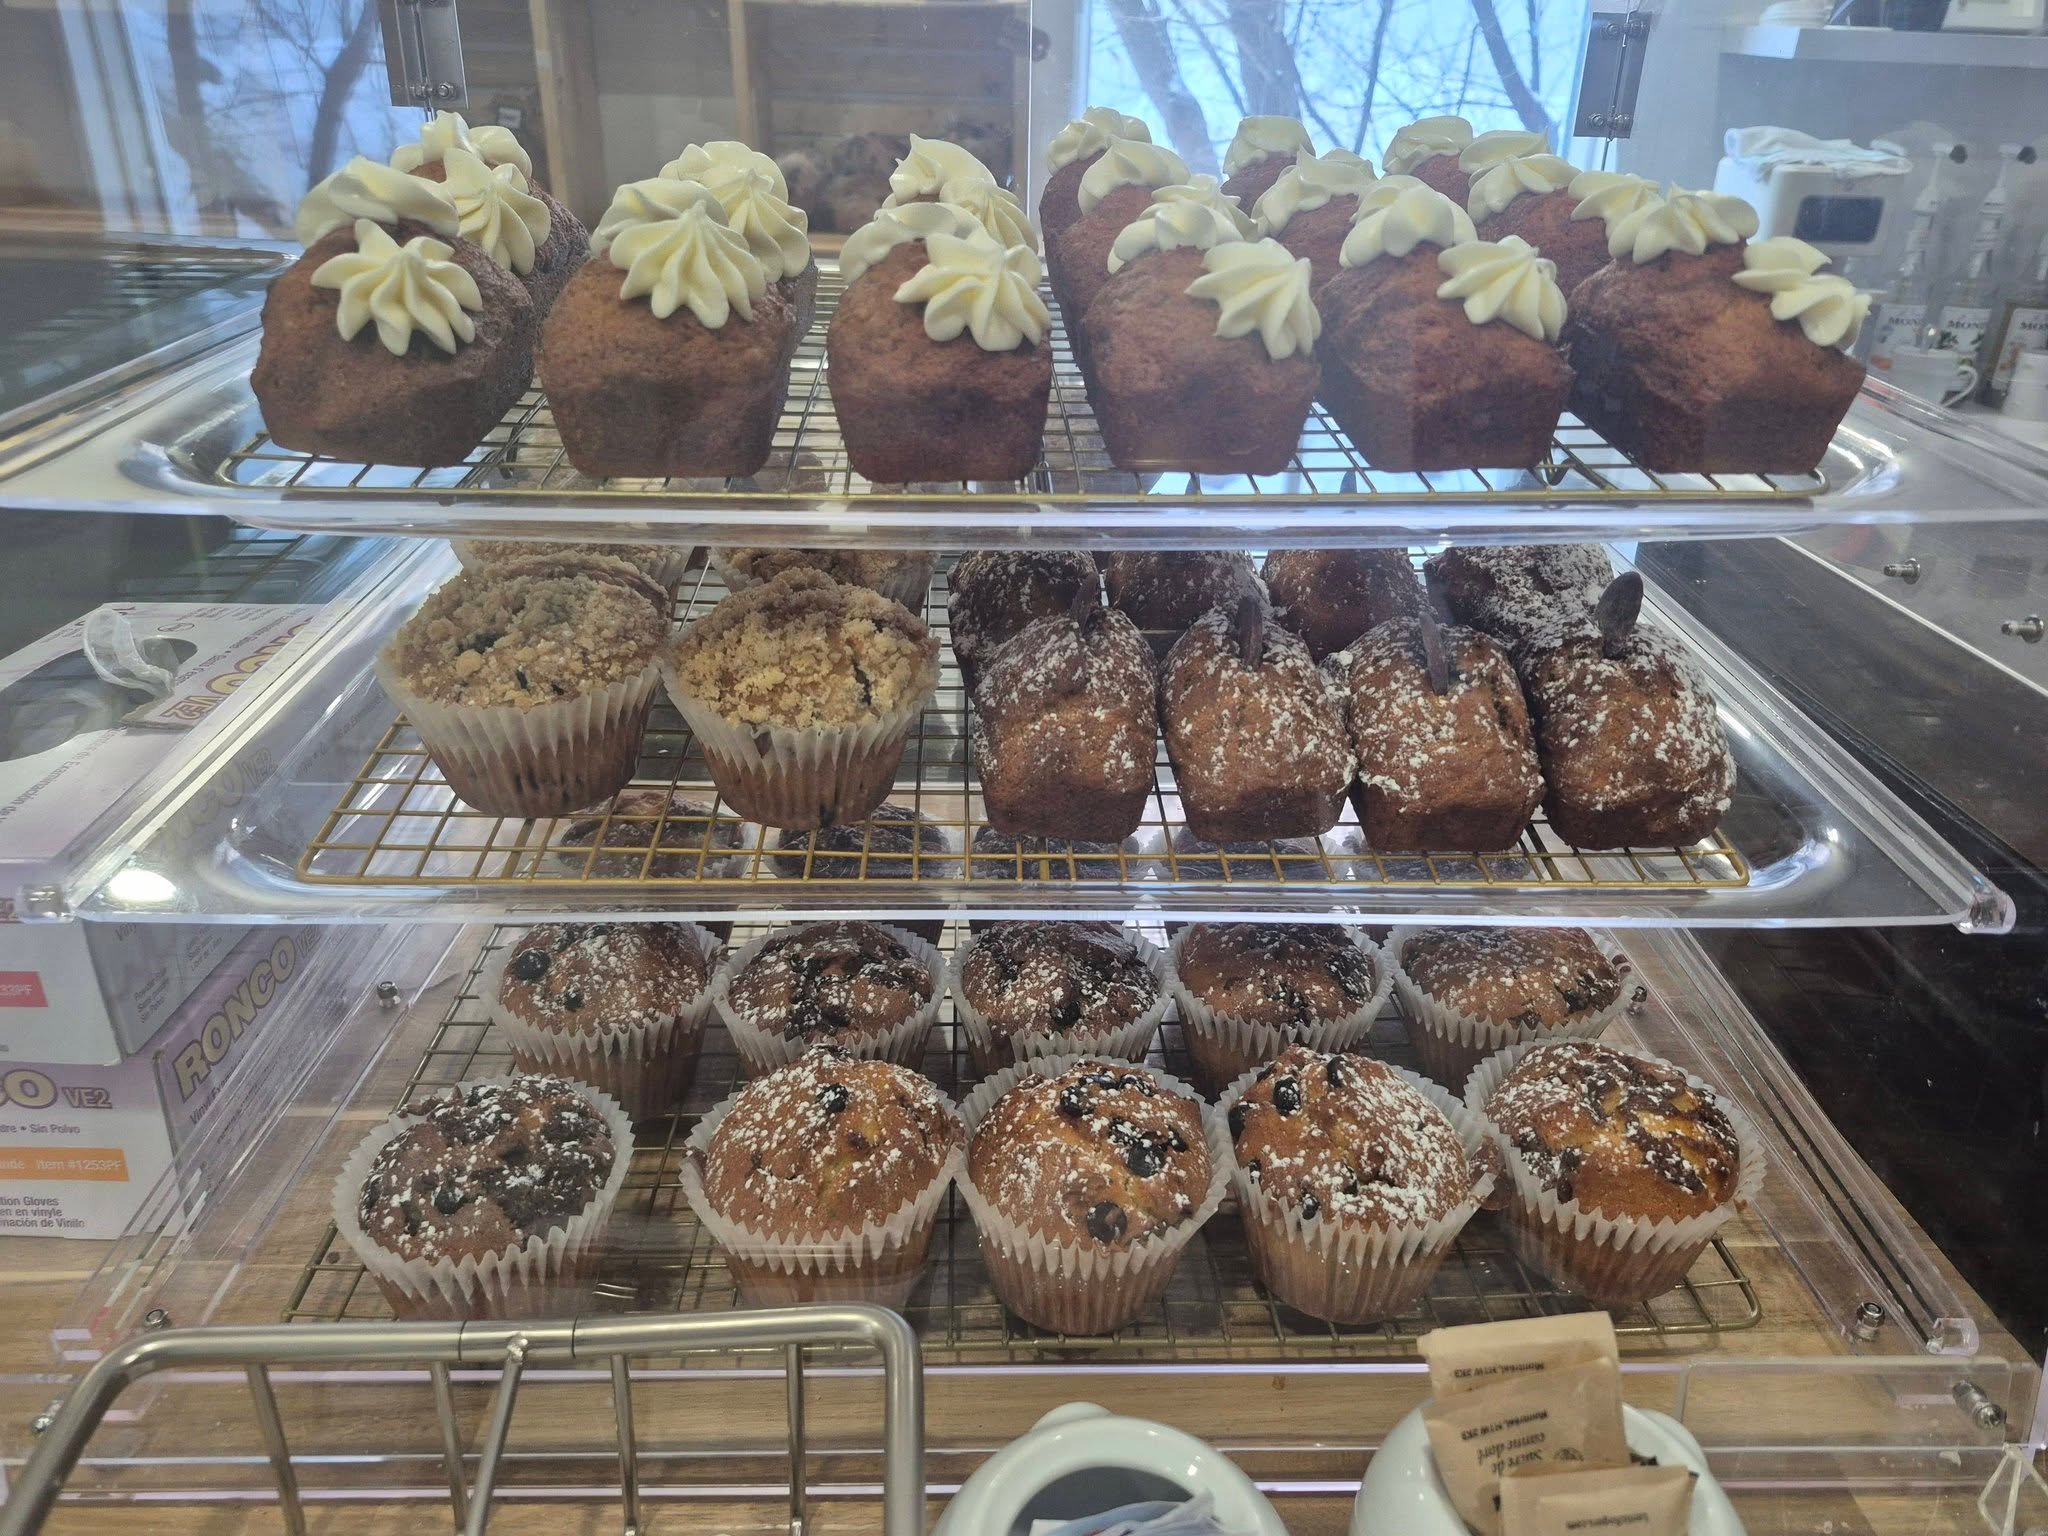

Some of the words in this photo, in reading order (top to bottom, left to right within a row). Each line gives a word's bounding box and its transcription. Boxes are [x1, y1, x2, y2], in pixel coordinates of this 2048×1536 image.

[172, 934, 297, 1104] RONCO
[61, 1086, 112, 1109] VE2
[30, 1124, 48, 1134] Sin
[23, 1196, 59, 1207] Gloves
[15, 1209, 30, 1217] en
[31, 1208, 62, 1219] vinyle
[40, 1217, 54, 1228] de
[1506, 1431, 1546, 1451] canne
[1492, 1461, 1505, 1478] de
